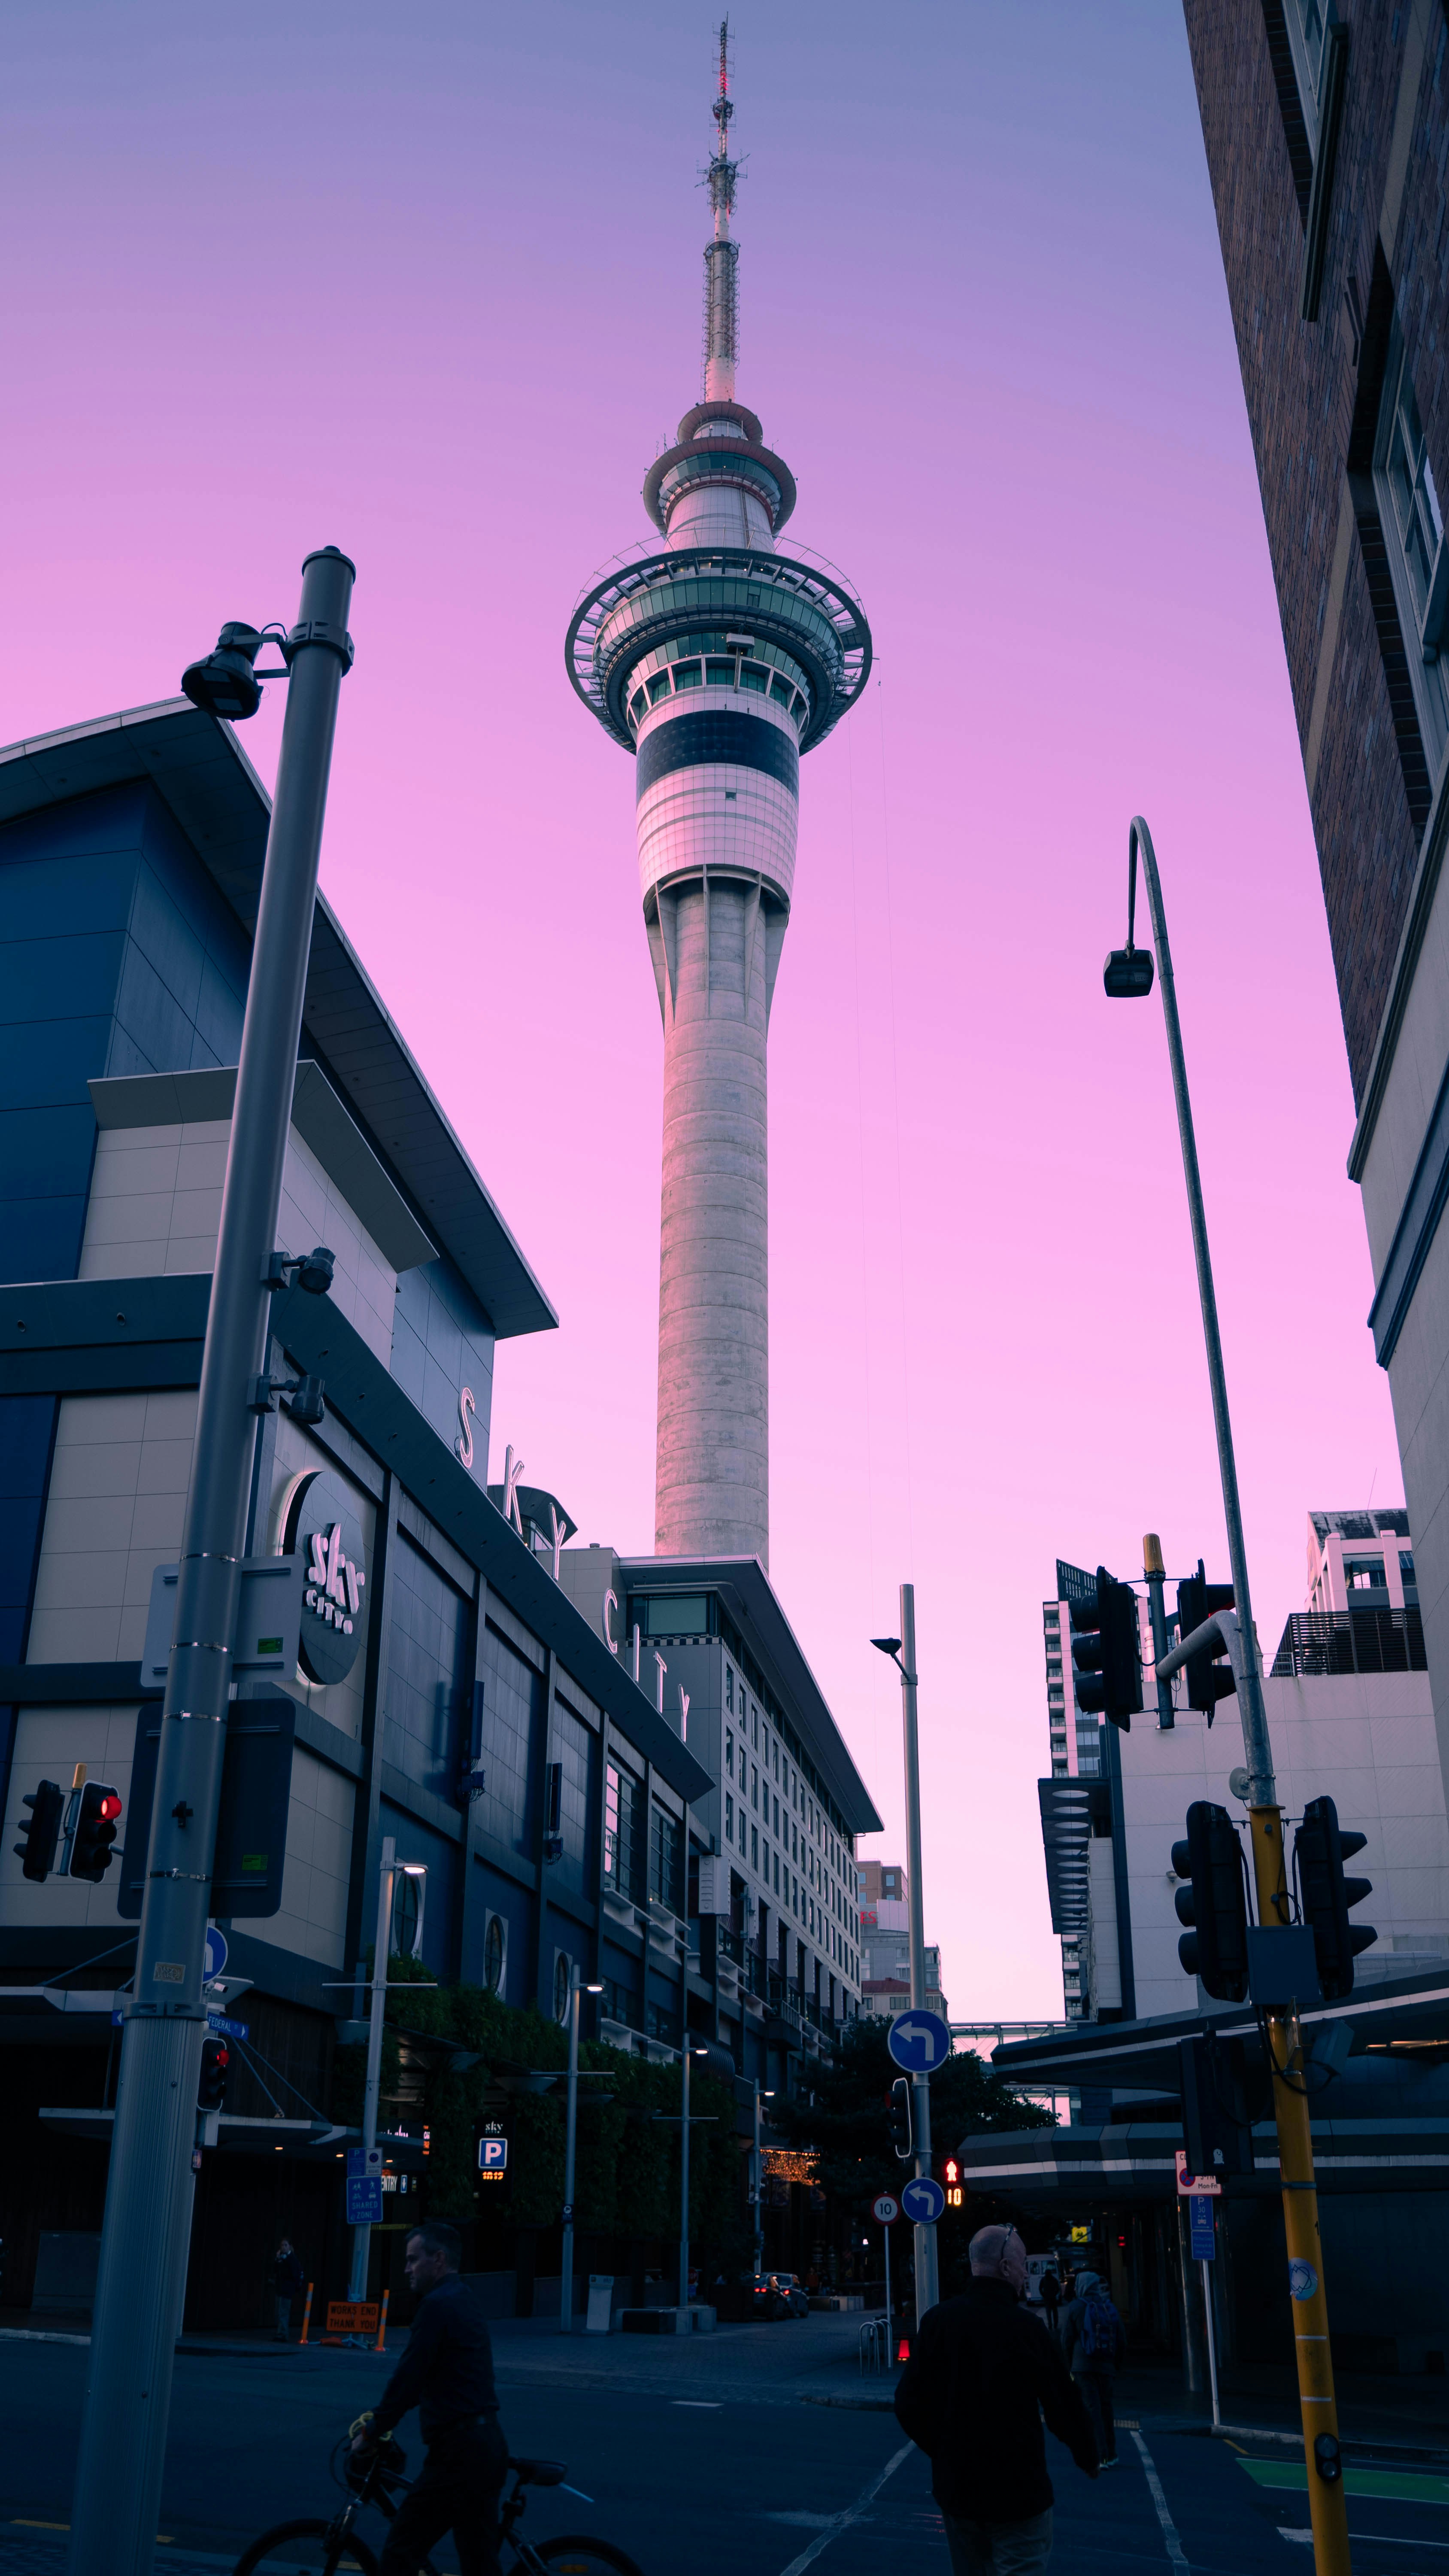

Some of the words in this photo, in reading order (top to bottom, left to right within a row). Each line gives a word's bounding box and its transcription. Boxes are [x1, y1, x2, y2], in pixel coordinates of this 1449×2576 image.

[456, 1386, 567, 1582] SKY
[602, 1588, 690, 1742] CITY
[208, 2016, 231, 2032] FEDERAL
[485, 2142, 502, 2164] P
[948, 2189, 961, 2206] 10
[1197, 2196, 1205, 2205] P
[352, 2201, 378, 2210] SHARED
[880, 2203, 891, 2215] 10
[356, 2211, 374, 2219] ZONE
[330, 2306, 357, 2314] WORKS
[361, 2306, 376, 2315] END
[330, 2318, 355, 2329] THANK
[360, 2320, 375, 2329] YOU
